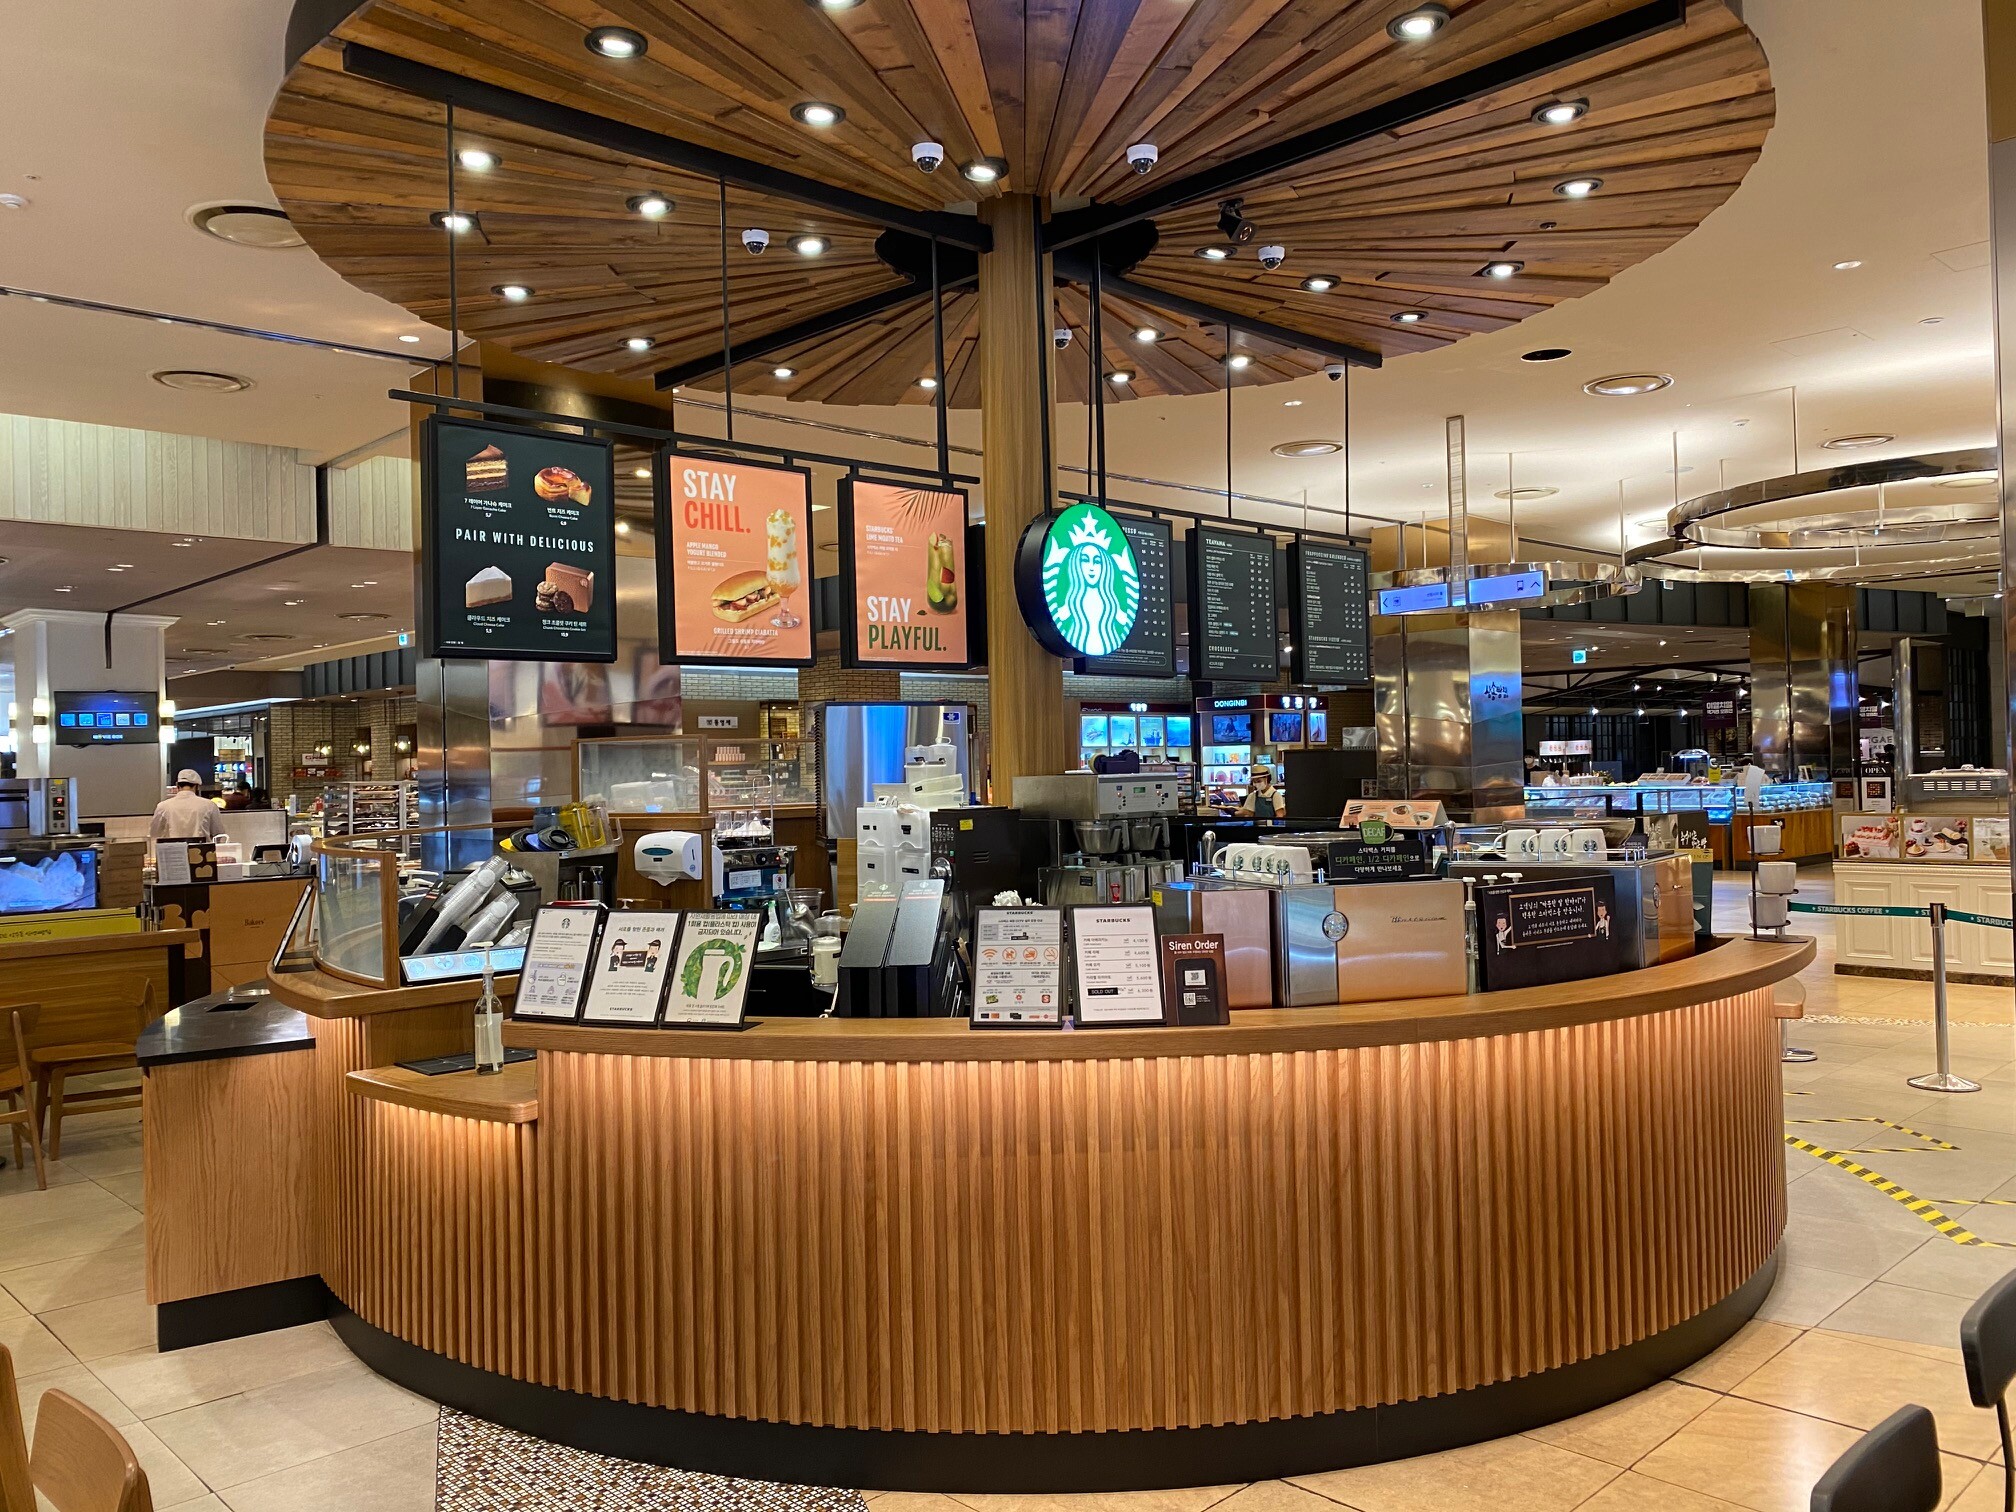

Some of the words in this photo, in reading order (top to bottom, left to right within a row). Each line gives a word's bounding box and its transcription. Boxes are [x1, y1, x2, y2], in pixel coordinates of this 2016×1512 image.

[683, 469, 736, 501] STAY
[684, 500, 751, 534] CHILL.
[455, 528, 487, 542] PAIR
[492, 531, 524, 546] WITH
[529, 535, 594, 553] DELICIOUS
[686, 541, 700, 549] APPLE
[895, 536, 903, 544] TEA
[686, 548, 705, 557] YOGURT
[706, 550, 727, 558] BLENDED
[866, 595, 911, 623] STAY
[713, 627, 734, 635] GRILLED
[755, 628, 778, 636] CIABATTA
[868, 624, 947, 651] PLAYFUL.
[1214, 699, 1248, 708] DONGINBI
[1363, 827, 1386, 837] DECAF
[1358, 846, 1379, 854] 스타벅스
[1335, 856, 1365, 865] 디카페인,
[1368, 855, 1380, 863] 1/2
[1382, 854, 1420, 863] 디카페인으로
[1354, 865, 1376, 873] 다양하게
[1817, 905, 1855, 914] STARBUCKS
[1976, 916, 2013, 927] STARBUC
[1168, 941, 1192, 951] Siren
[1194, 940, 1219, 950] Order
